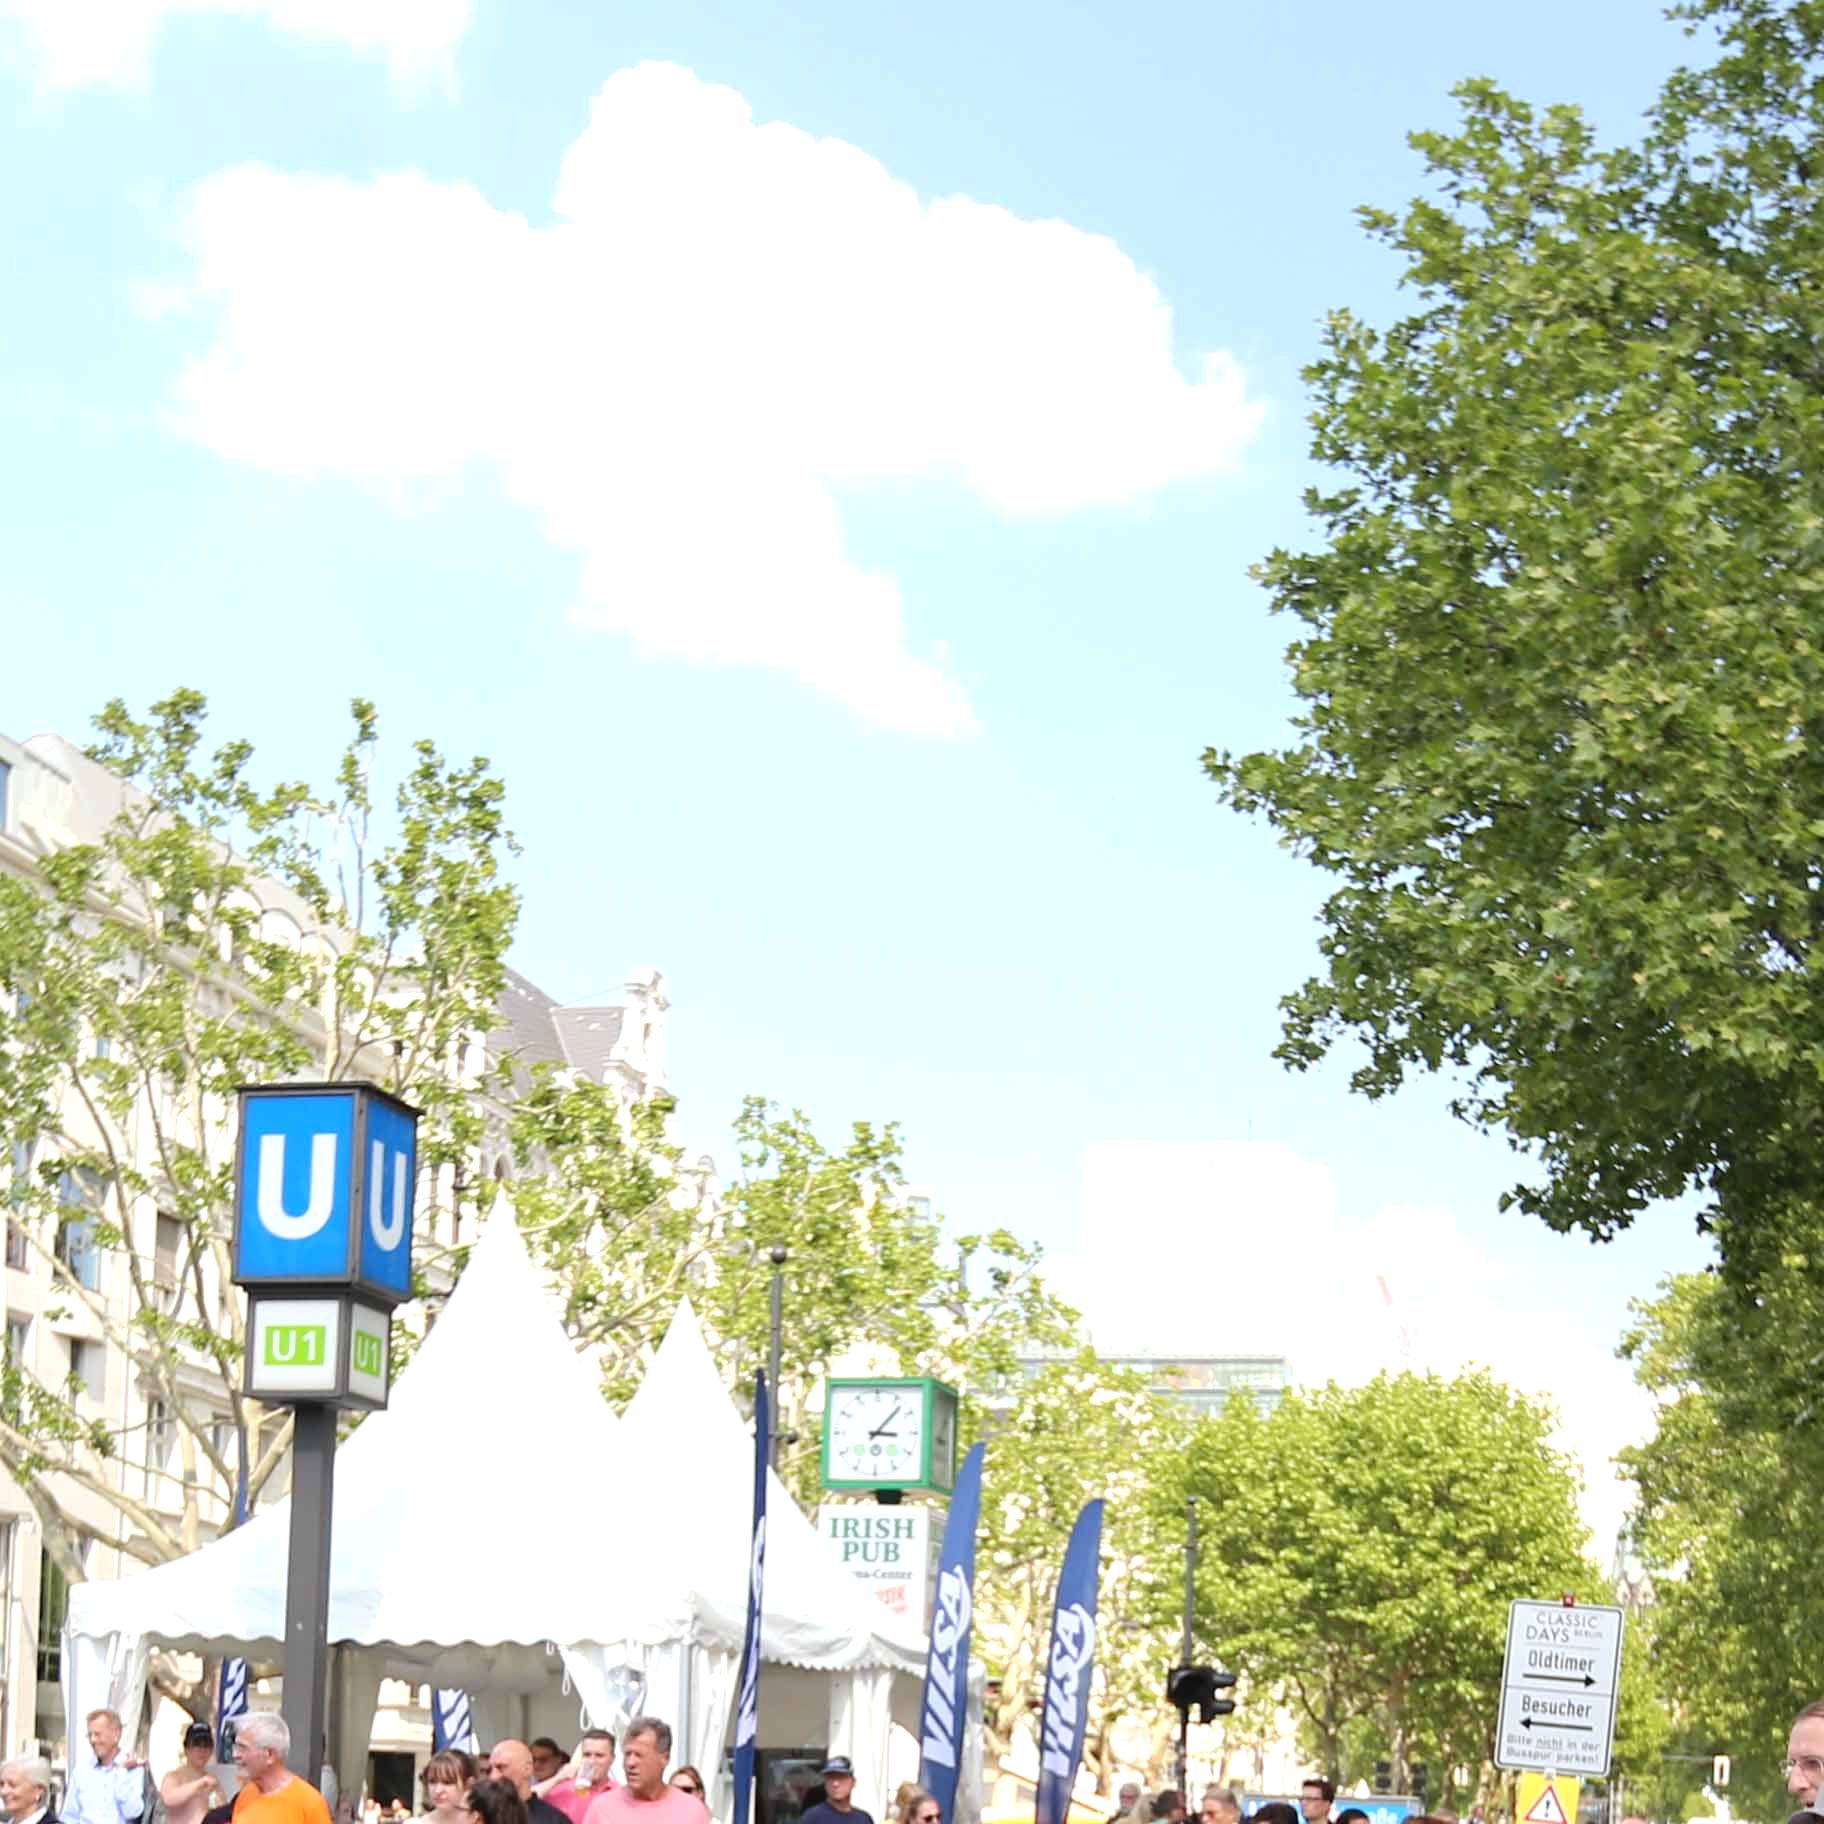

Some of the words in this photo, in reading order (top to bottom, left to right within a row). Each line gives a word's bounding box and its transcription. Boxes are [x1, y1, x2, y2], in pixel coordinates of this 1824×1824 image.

[258, 1133, 337, 1240] U
[369, 1138, 407, 1252] U
[272, 1329, 317, 1361] U1
[356, 1335, 379, 1371] U1
[829, 1517, 916, 1539] IRISH
[841, 1540, 901, 1562] PUB
[1525, 1624, 1570, 1643] DAYS
[1536, 1611, 1599, 1629] CLASSIC
[922, 1566, 971, 1768] VILSA
[1528, 1650, 1596, 1673] Oldtimer
[1043, 1603, 1095, 1777] VILSA
[1521, 1694, 1592, 1717] Besucher
